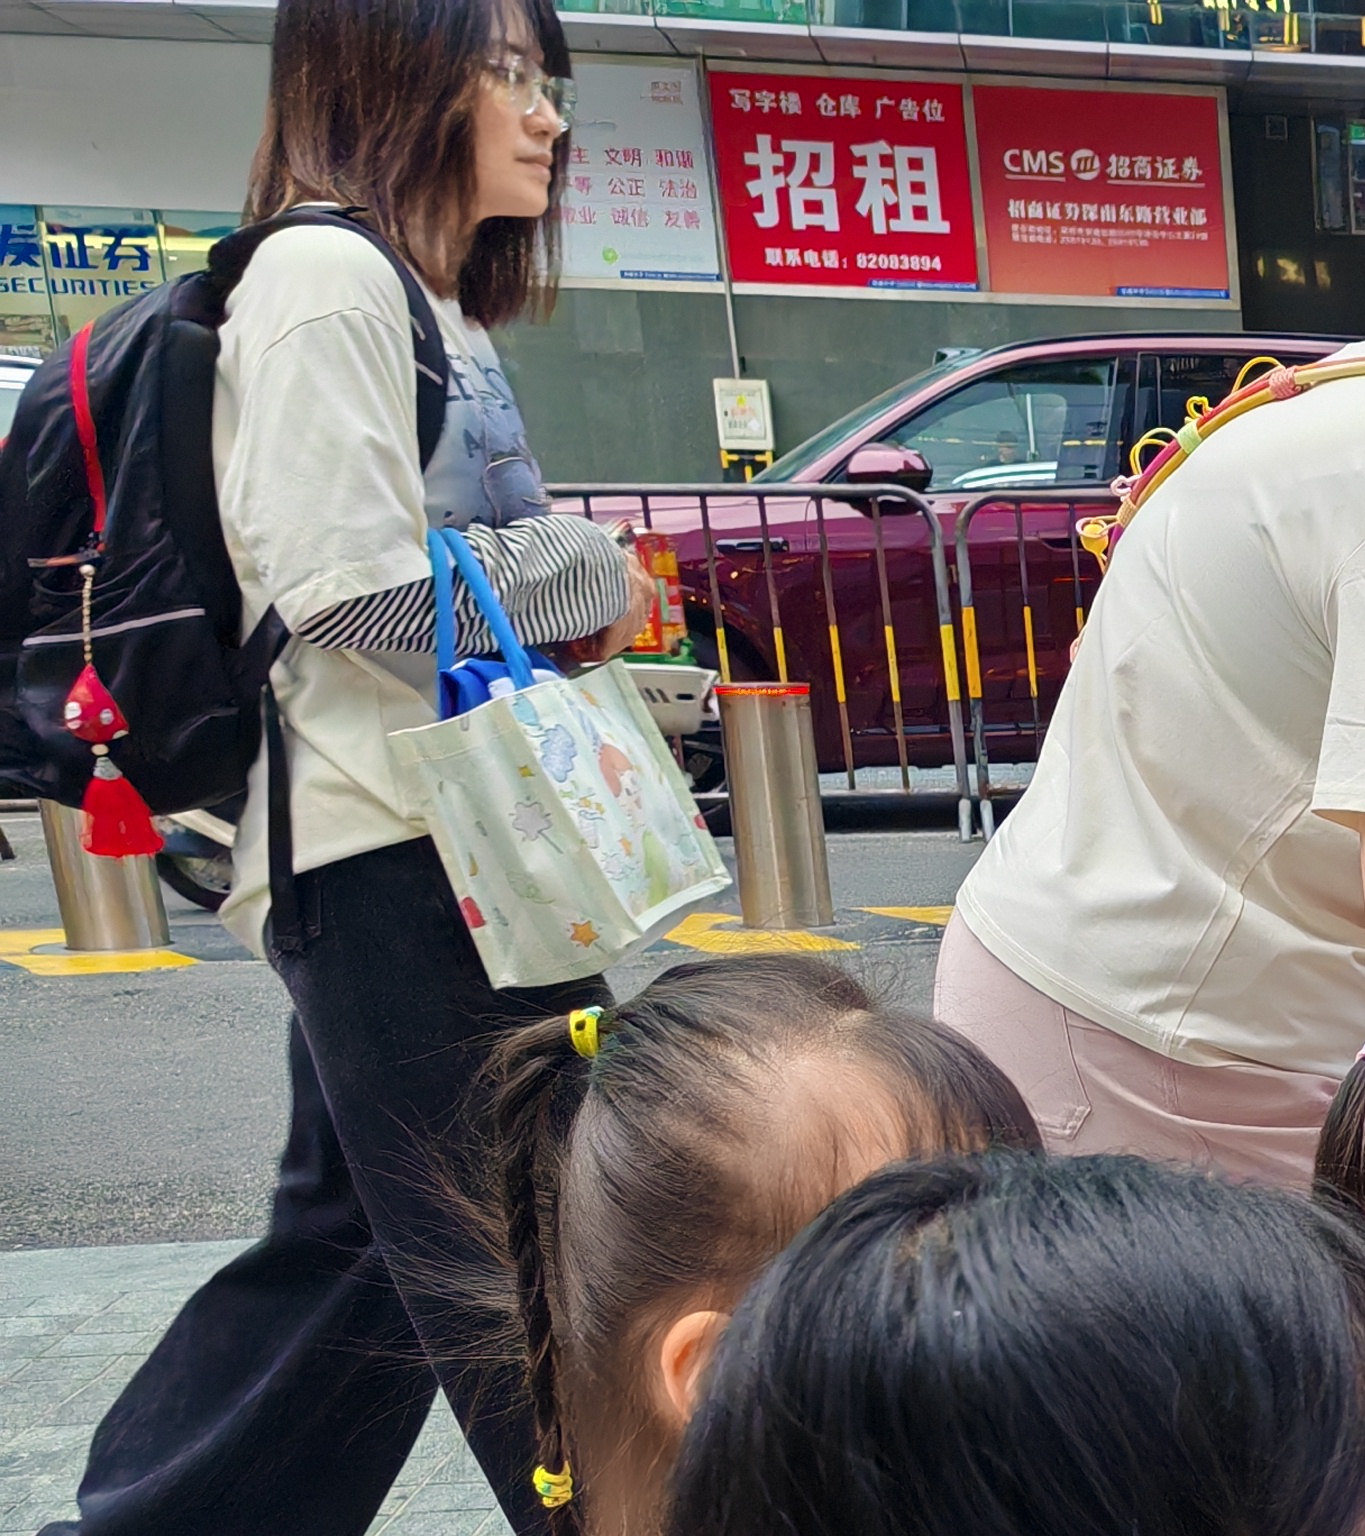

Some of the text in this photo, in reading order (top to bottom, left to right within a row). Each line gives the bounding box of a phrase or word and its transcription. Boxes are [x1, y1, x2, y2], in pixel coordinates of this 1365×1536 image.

[729, 88, 945, 122] 写字楼 仓库 广告位
[604, 147, 643, 168] 文明
[1003, 149, 1065, 175] CMS
[608, 176, 645, 198] 公正
[658, 178, 698, 199] 法治
[744, 134, 951, 235] 招租
